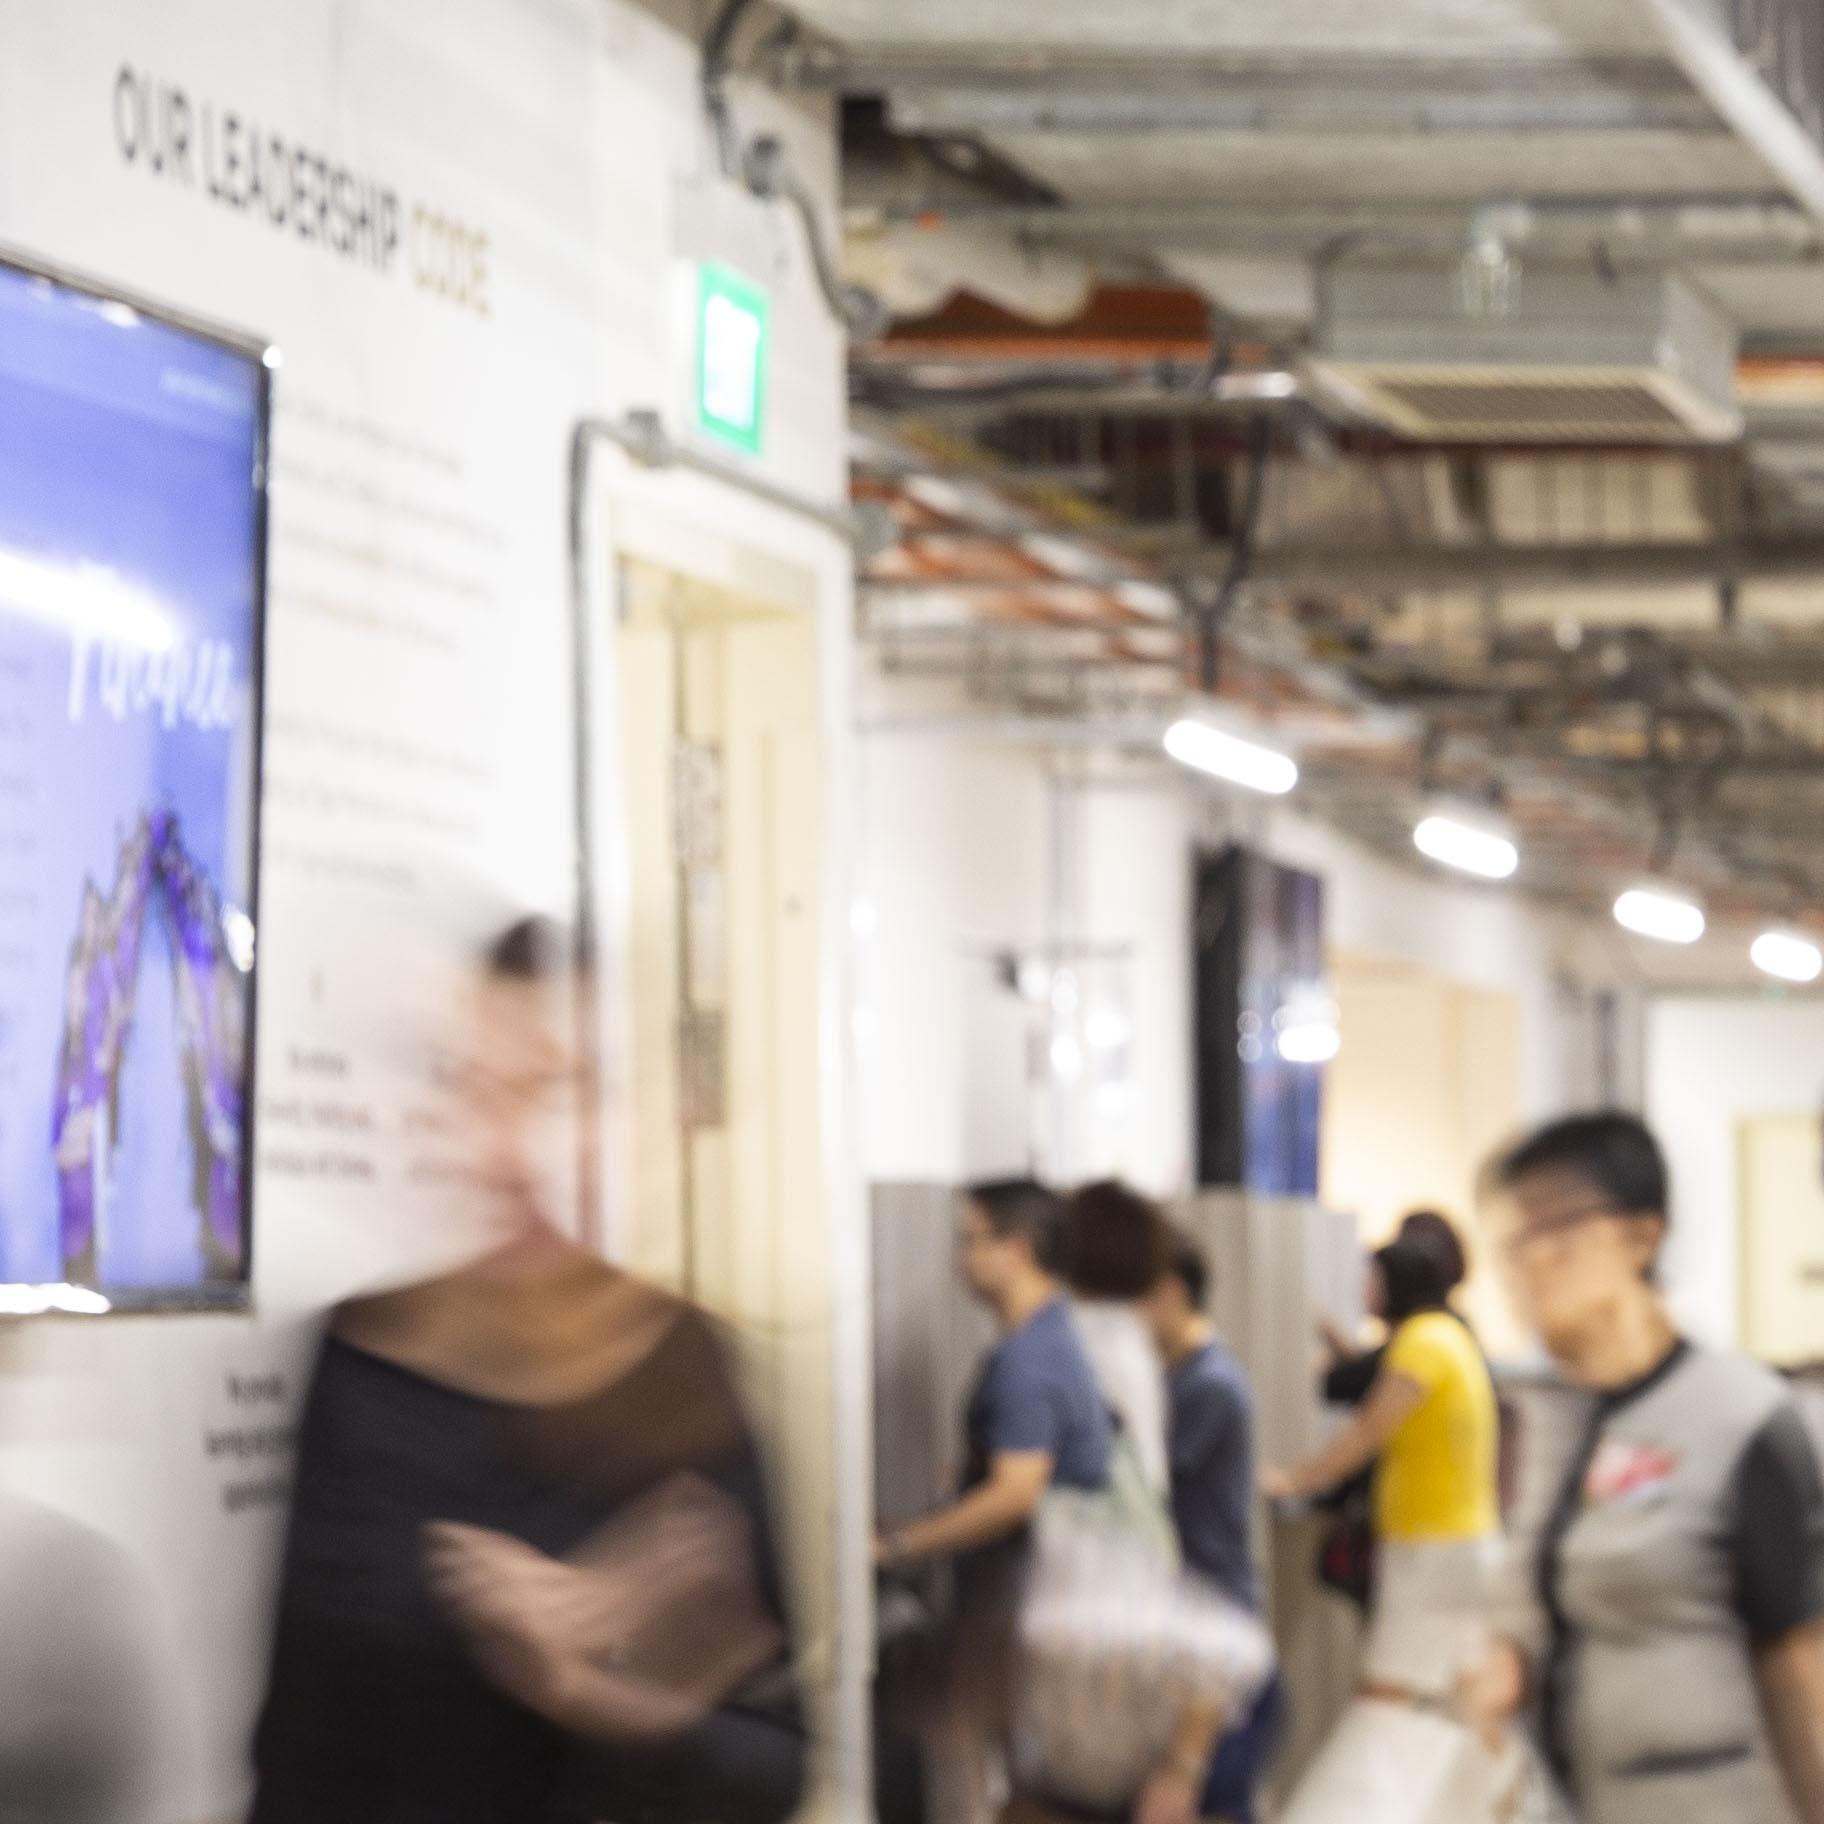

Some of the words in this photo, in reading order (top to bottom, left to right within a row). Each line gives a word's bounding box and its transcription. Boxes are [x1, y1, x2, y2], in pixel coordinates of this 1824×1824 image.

[114, 63, 195, 187] OUR
[202, 98, 400, 276] LEADERSHIP
[412, 201, 494, 317] CODE
